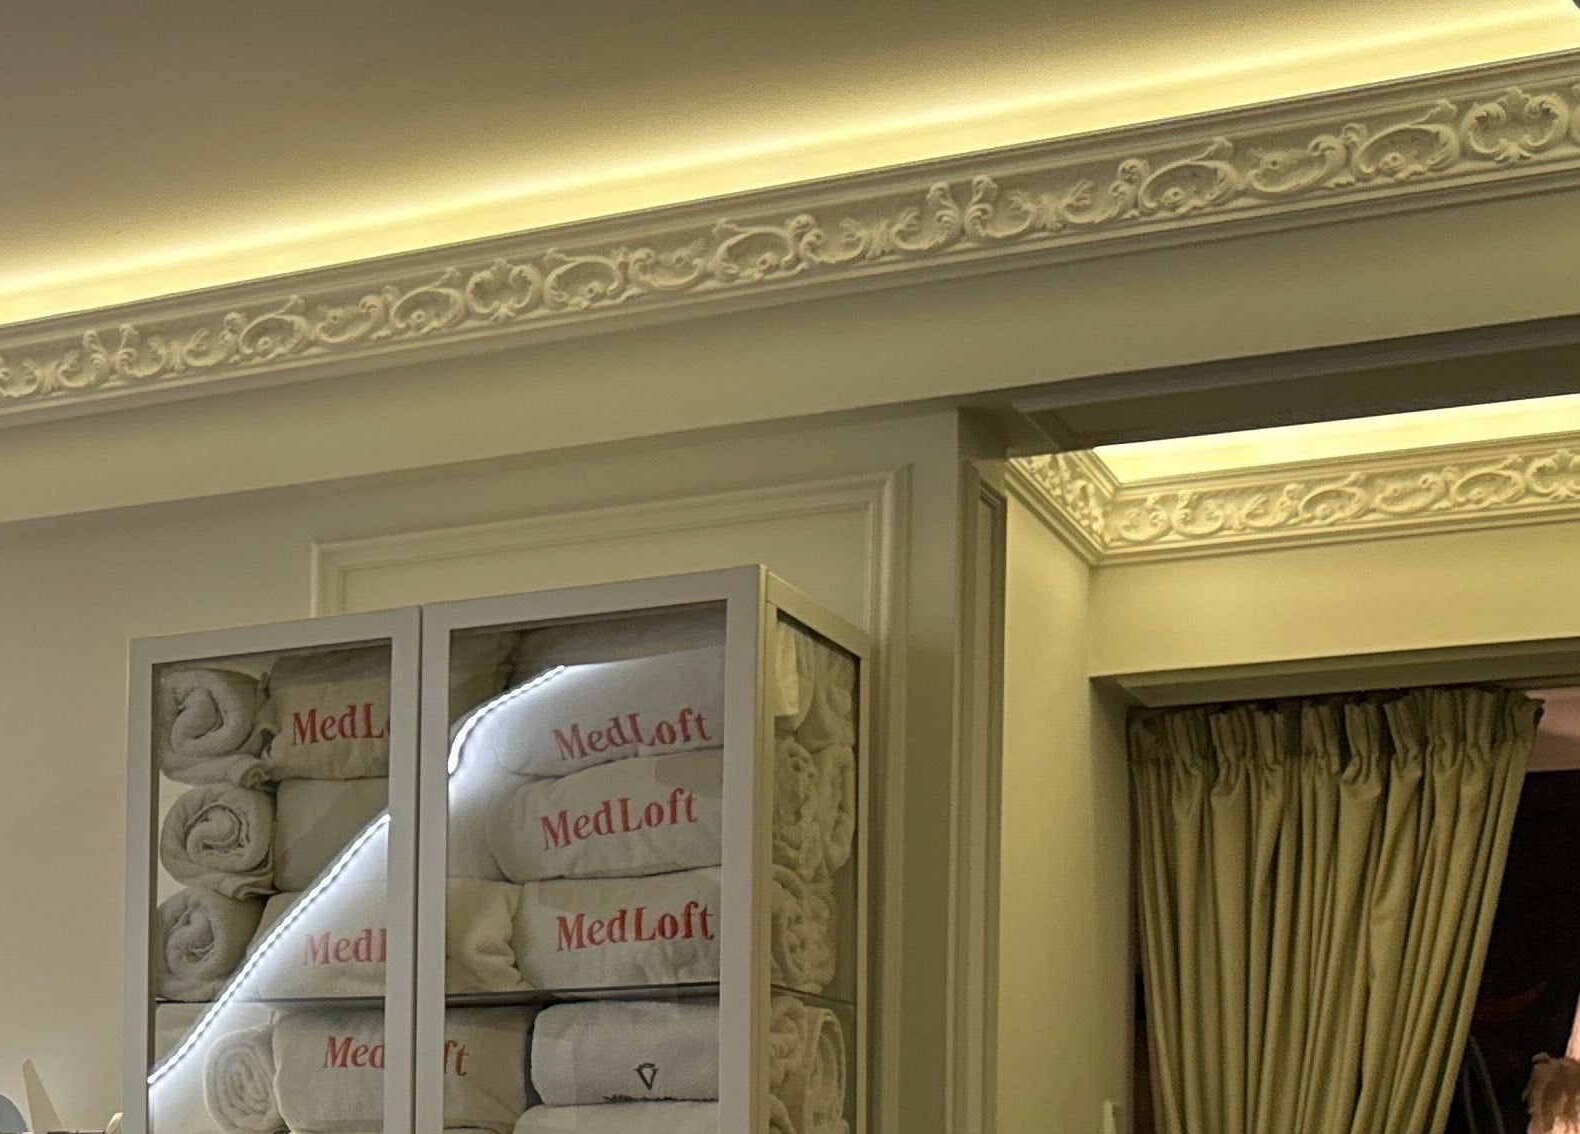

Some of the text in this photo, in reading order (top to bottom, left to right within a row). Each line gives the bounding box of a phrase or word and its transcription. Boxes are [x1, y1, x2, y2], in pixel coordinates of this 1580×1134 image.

[291, 703, 390, 746] MedL
[552, 708, 712, 761] MedLoft
[540, 787, 698, 850] MedLoft
[555, 901, 715, 951] MedLoft
